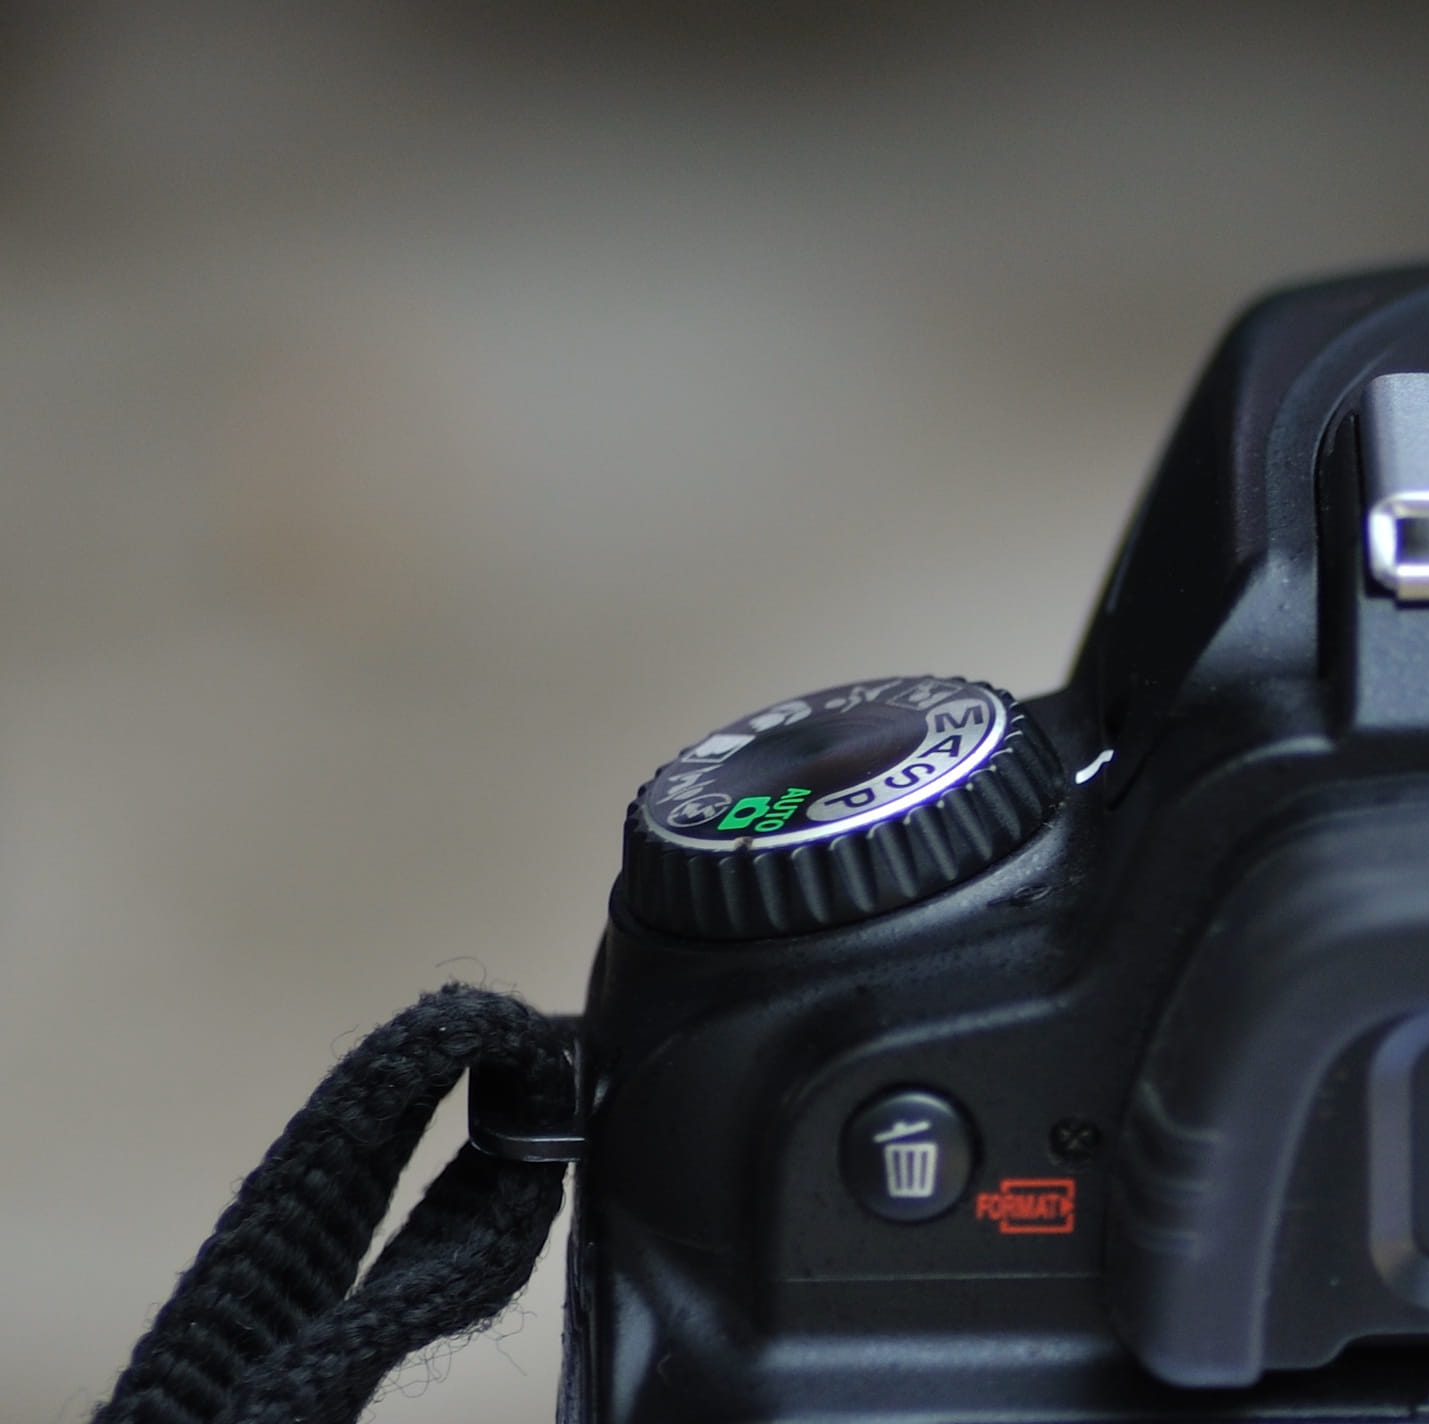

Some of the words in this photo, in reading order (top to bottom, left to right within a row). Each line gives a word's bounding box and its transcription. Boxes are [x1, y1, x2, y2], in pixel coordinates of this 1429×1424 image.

[934, 705, 983, 733] M
[918, 735, 962, 758] A
[884, 763, 936, 788] S
[754, 787, 812, 833] AUTO
[824, 787, 876, 808] P
